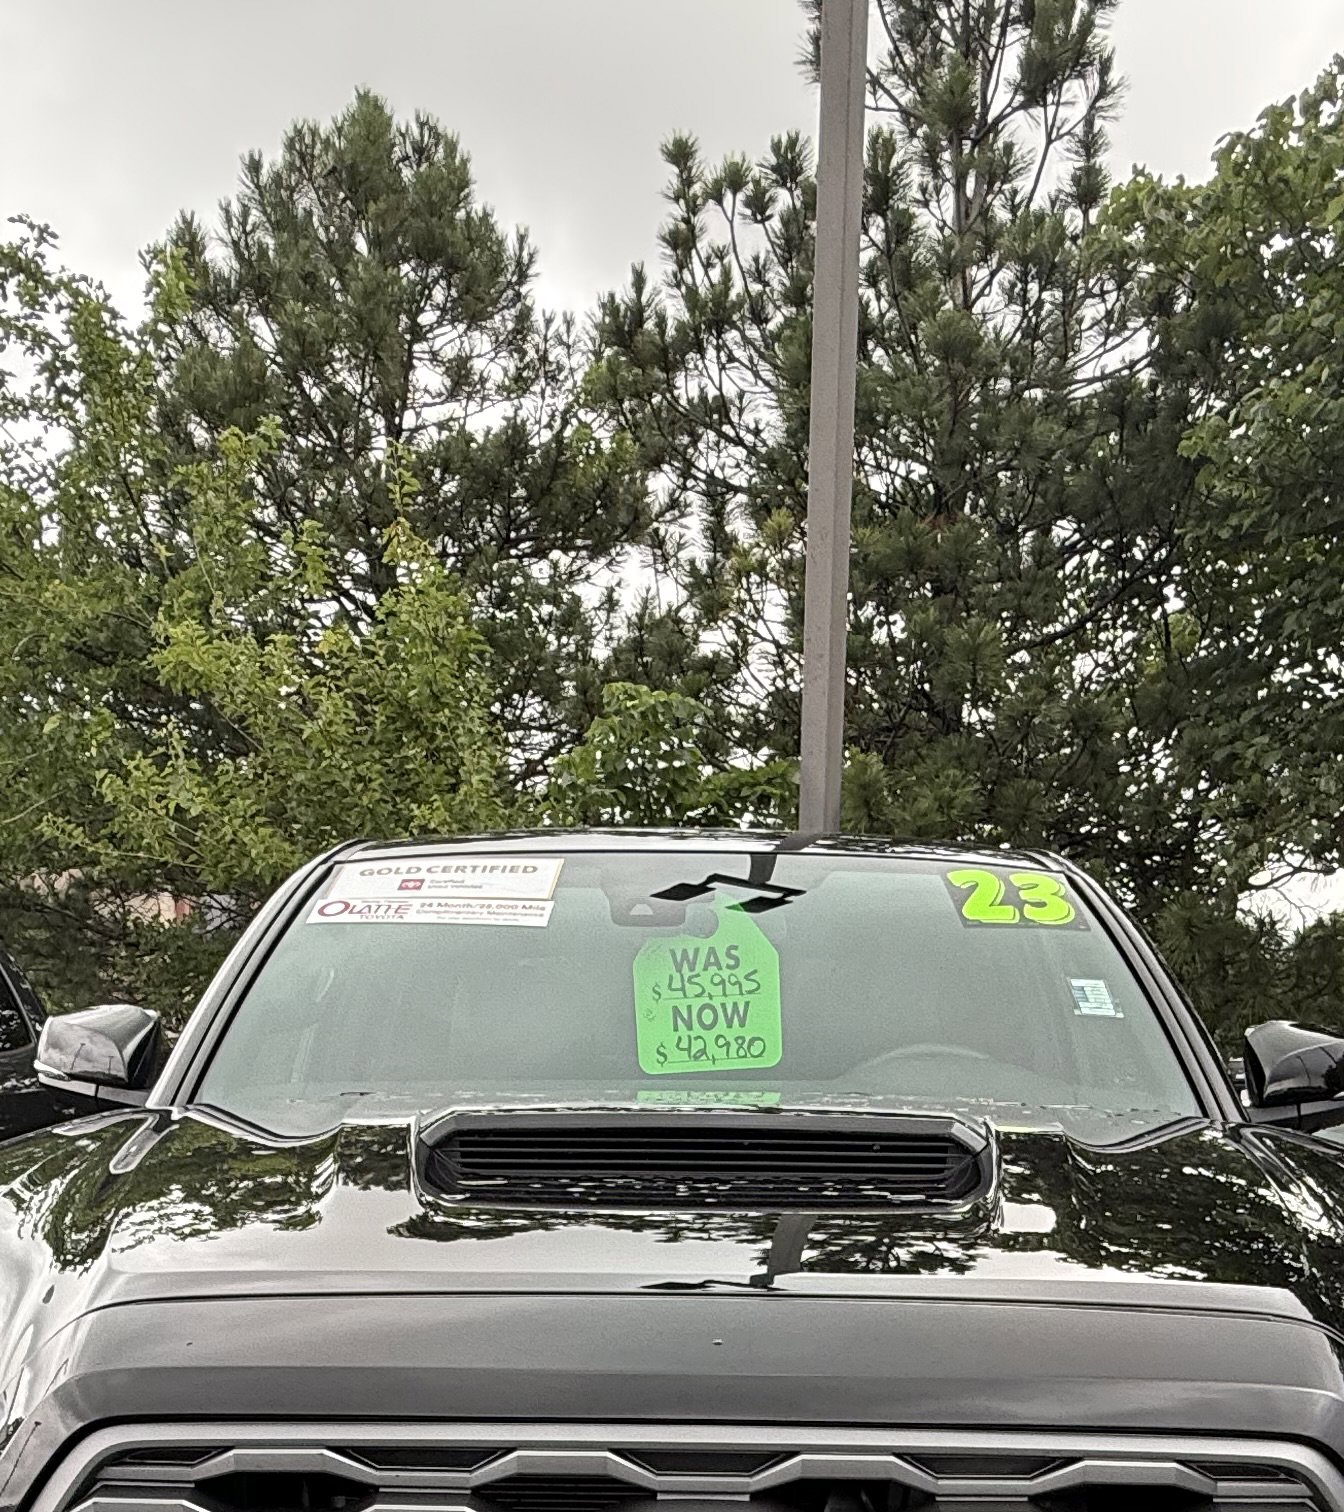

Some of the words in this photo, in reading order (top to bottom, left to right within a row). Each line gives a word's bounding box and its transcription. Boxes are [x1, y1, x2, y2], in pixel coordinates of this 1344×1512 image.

[360, 867, 422, 876] GOLD
[426, 865, 538, 874] CERTIFIED
[947, 870, 1076, 925] 23
[670, 945, 740, 972] WAS
[671, 1001, 751, 1033] NOW
